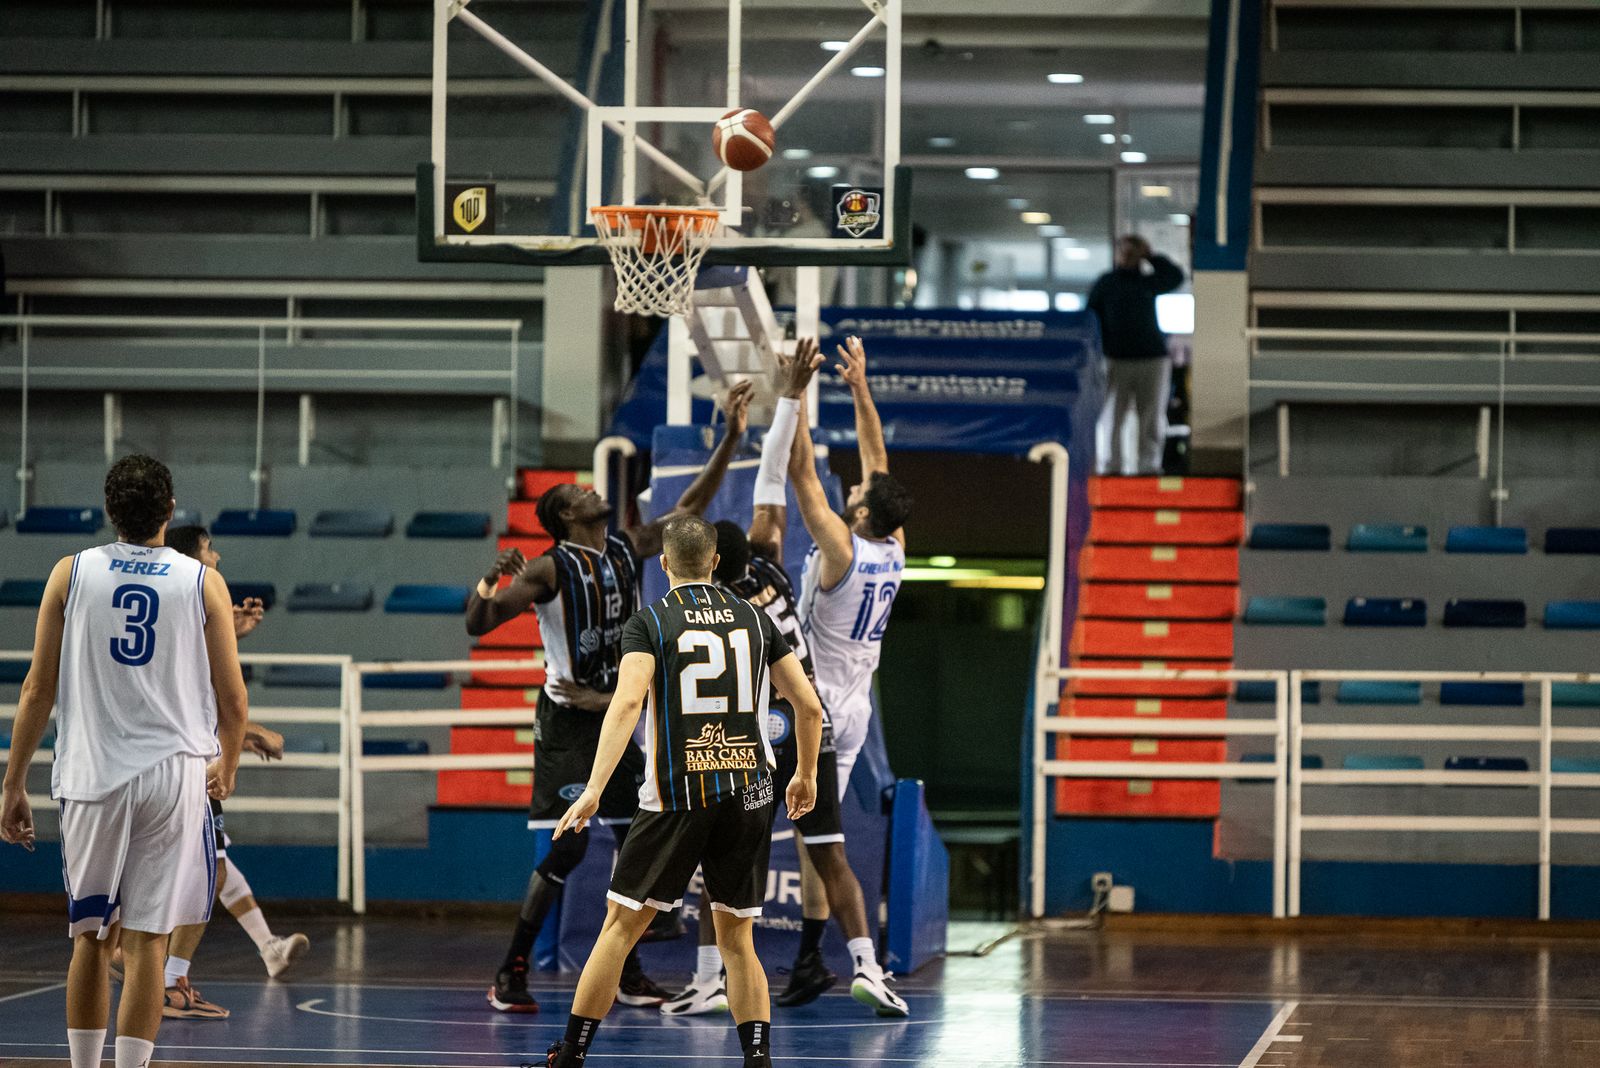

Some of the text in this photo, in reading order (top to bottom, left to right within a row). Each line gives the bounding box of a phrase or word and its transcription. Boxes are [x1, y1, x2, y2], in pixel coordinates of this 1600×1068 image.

[109, 558, 171, 576] PÉREZ
[605, 593, 622, 619] 12
[684, 607, 735, 624] CAÑAS
[850, 582, 897, 641] 12
[110, 584, 160, 667] 3
[677, 629, 754, 715] 21
[685, 748, 757, 763] BAR CASA
[686, 760, 757, 771] HERMANDAD
